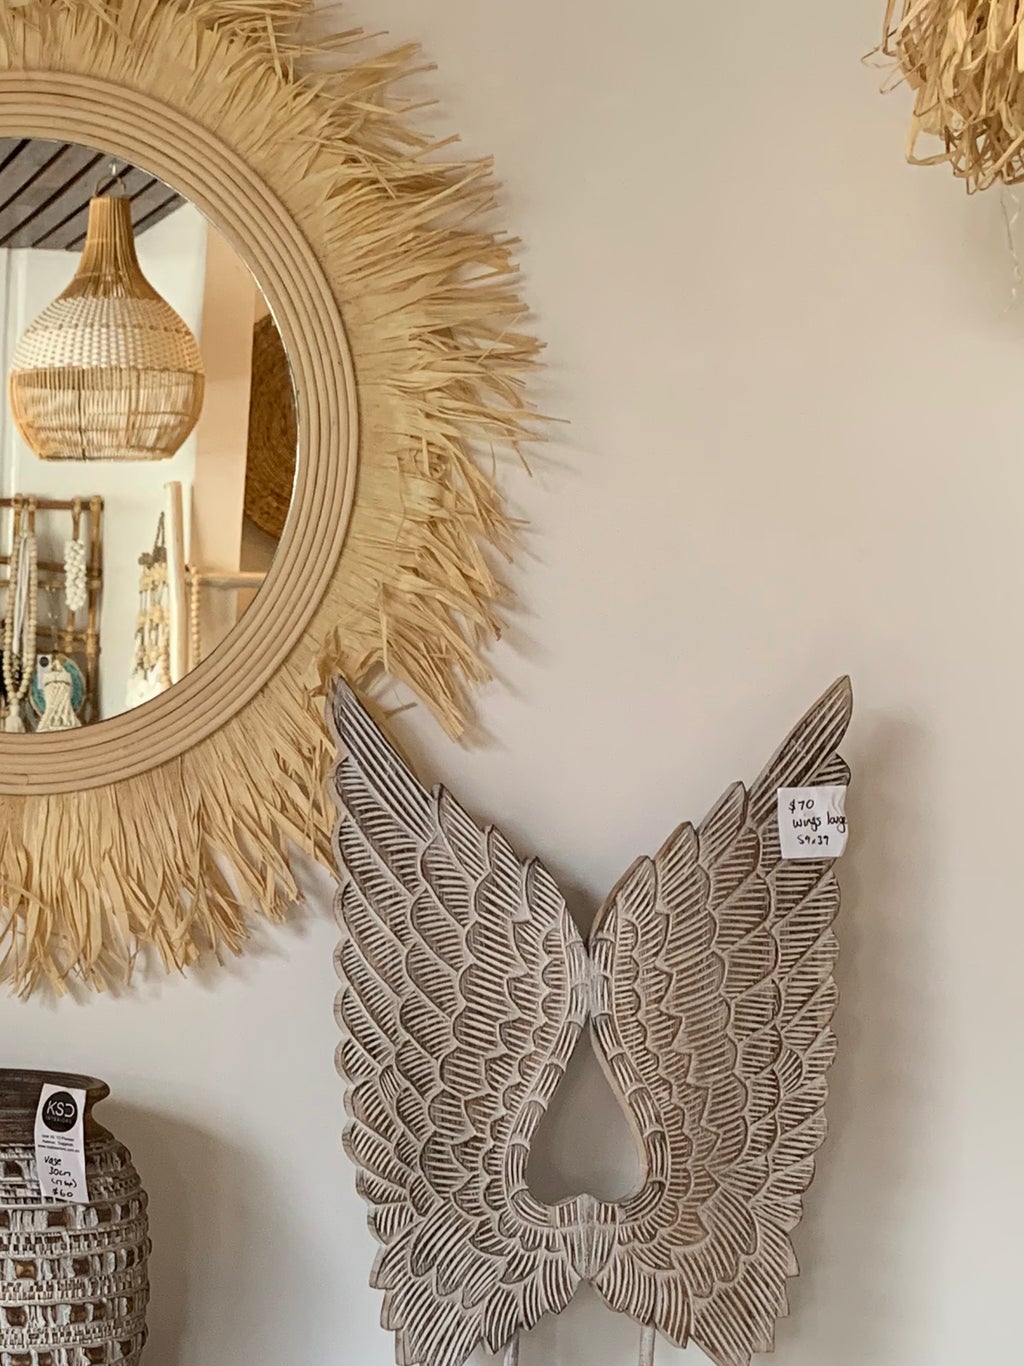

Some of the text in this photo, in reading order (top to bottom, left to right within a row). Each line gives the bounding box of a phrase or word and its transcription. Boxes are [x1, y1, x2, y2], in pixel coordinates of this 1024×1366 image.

[788, 798, 815, 815] $70
[792, 815, 822, 833] wings
[46, 1100, 75, 1118] KSD
